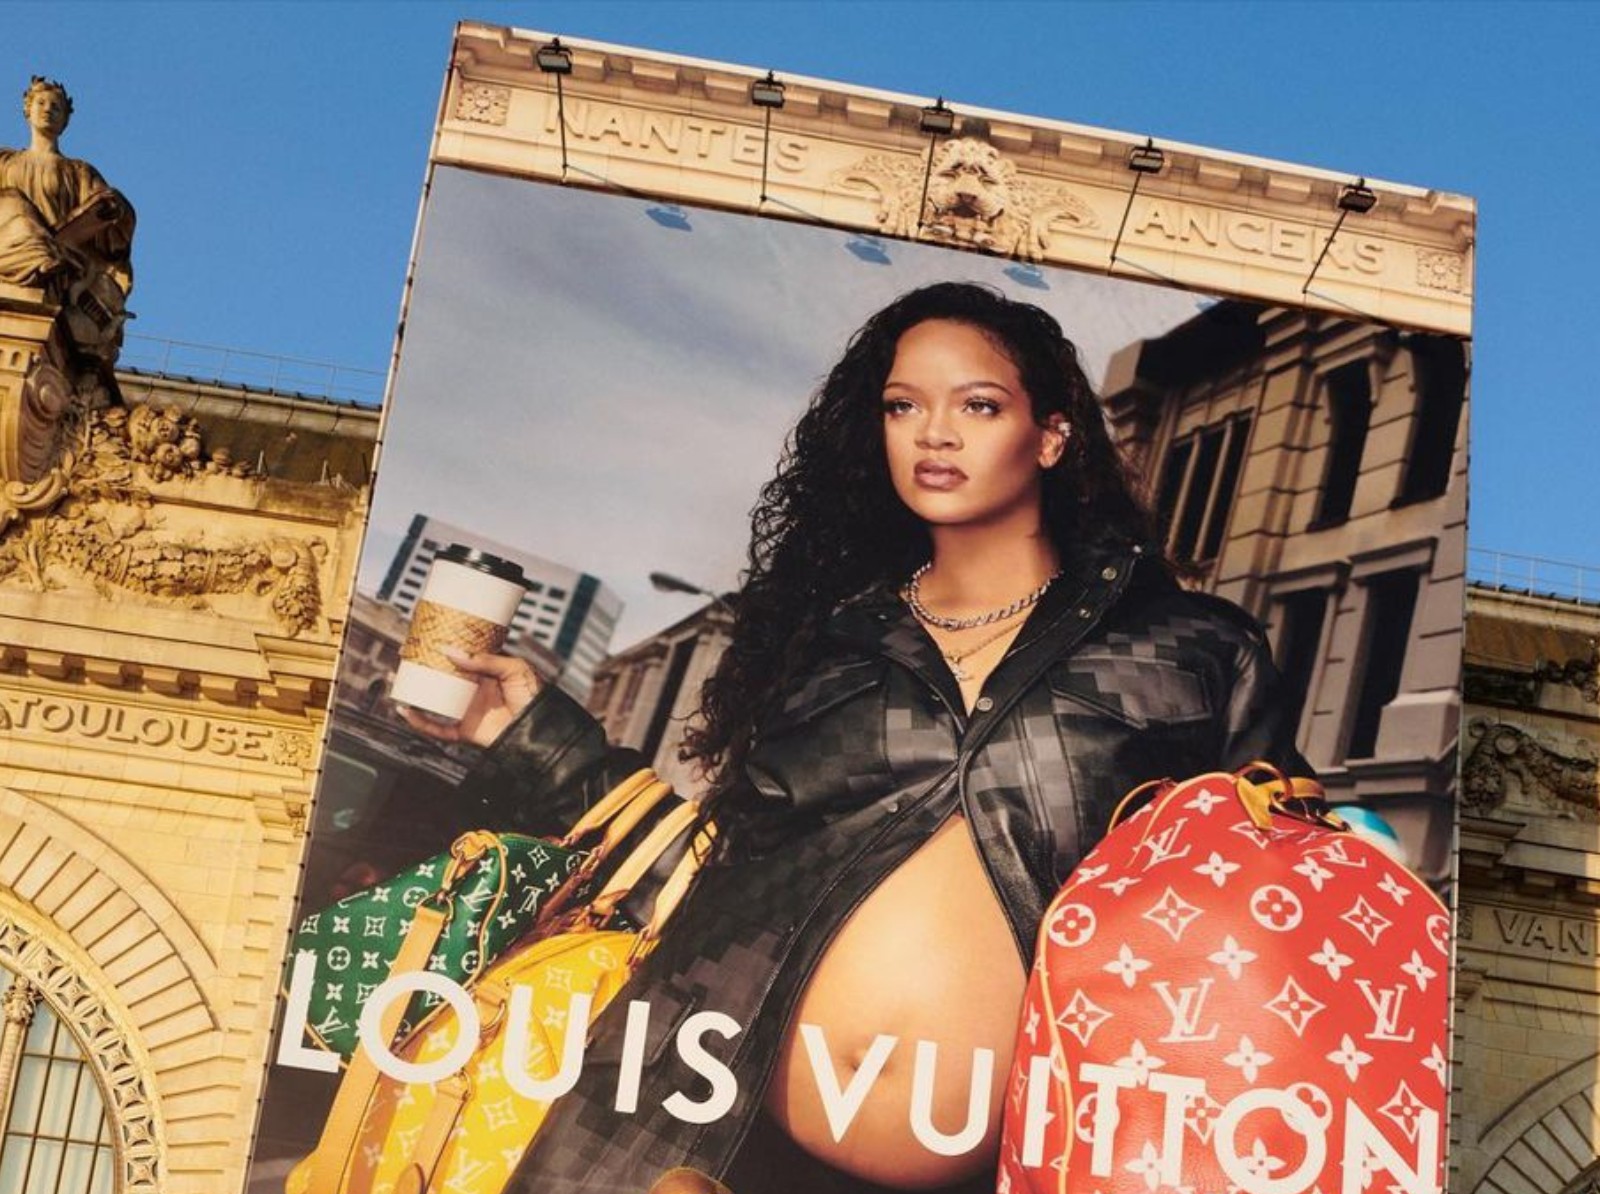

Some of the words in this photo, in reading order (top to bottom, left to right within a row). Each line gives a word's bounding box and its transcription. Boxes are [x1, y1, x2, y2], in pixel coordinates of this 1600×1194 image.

[546, 99, 808, 173] NANTES
[1134, 202, 1386, 275] ANGERS
[1493, 908, 1590, 956] VAN
[277, 952, 742, 1125] LOUIS
